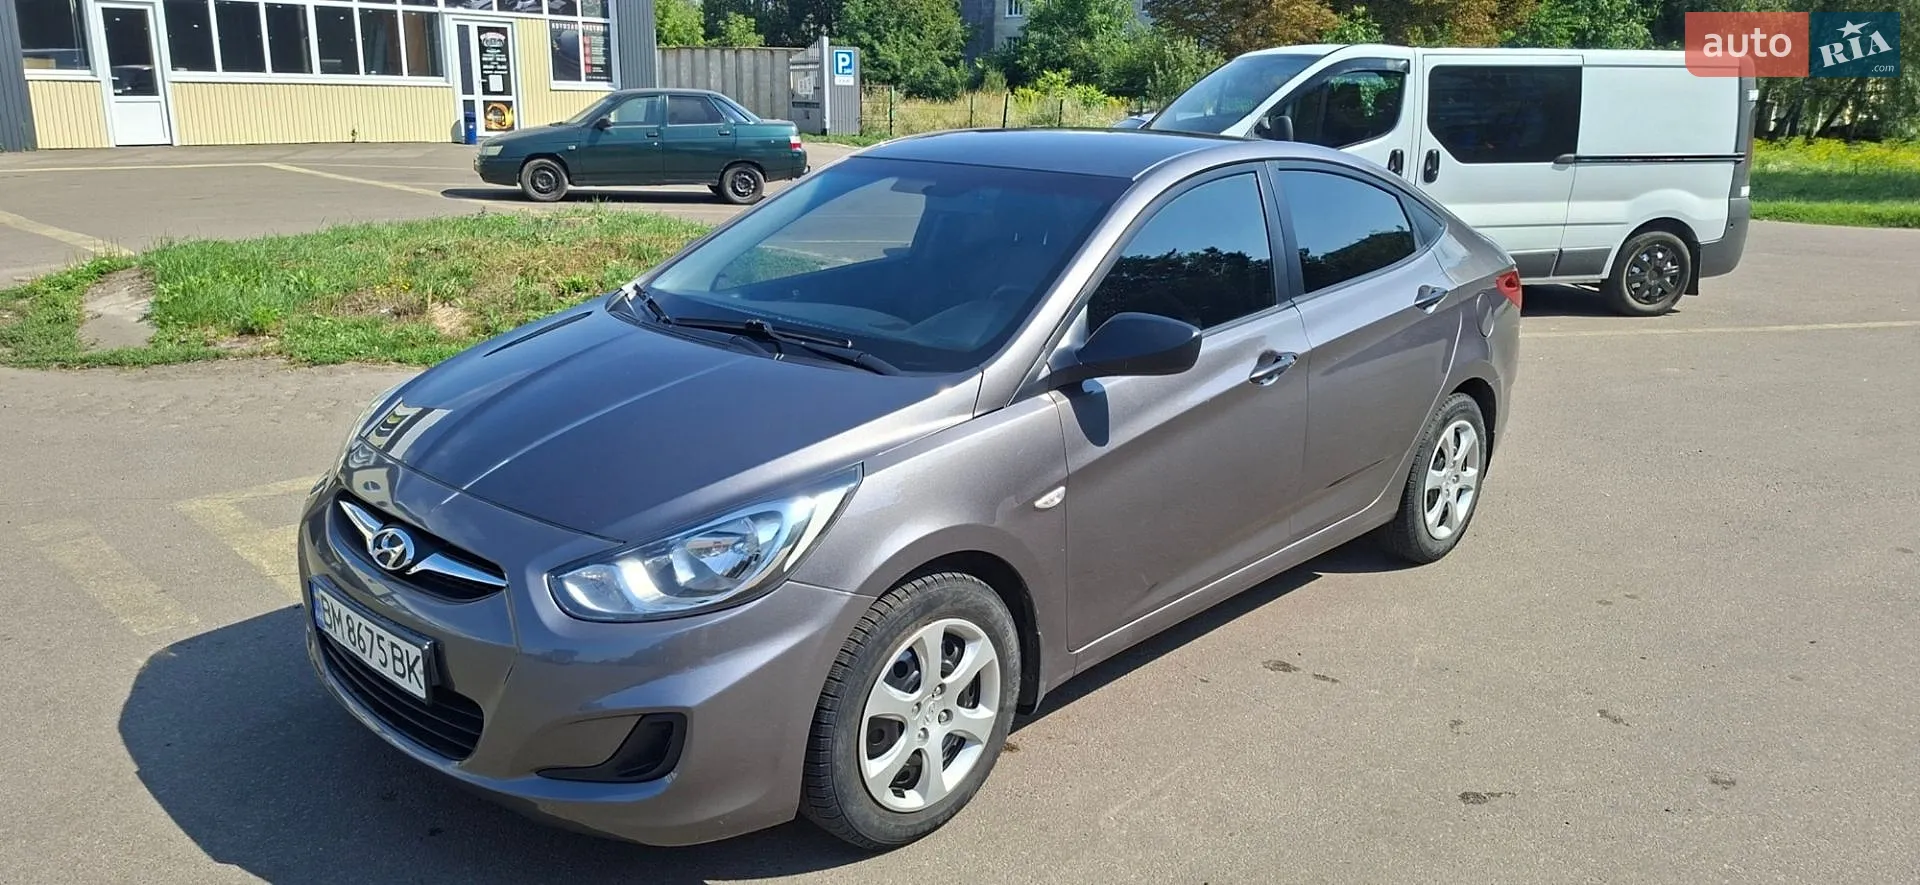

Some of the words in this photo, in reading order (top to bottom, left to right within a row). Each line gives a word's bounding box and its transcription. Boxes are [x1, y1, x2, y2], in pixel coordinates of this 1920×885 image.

[837, 53, 851, 74] P
[320, 593, 345, 641] BM
[346, 613, 388, 669] 8675
[390, 640, 424, 690] BK
